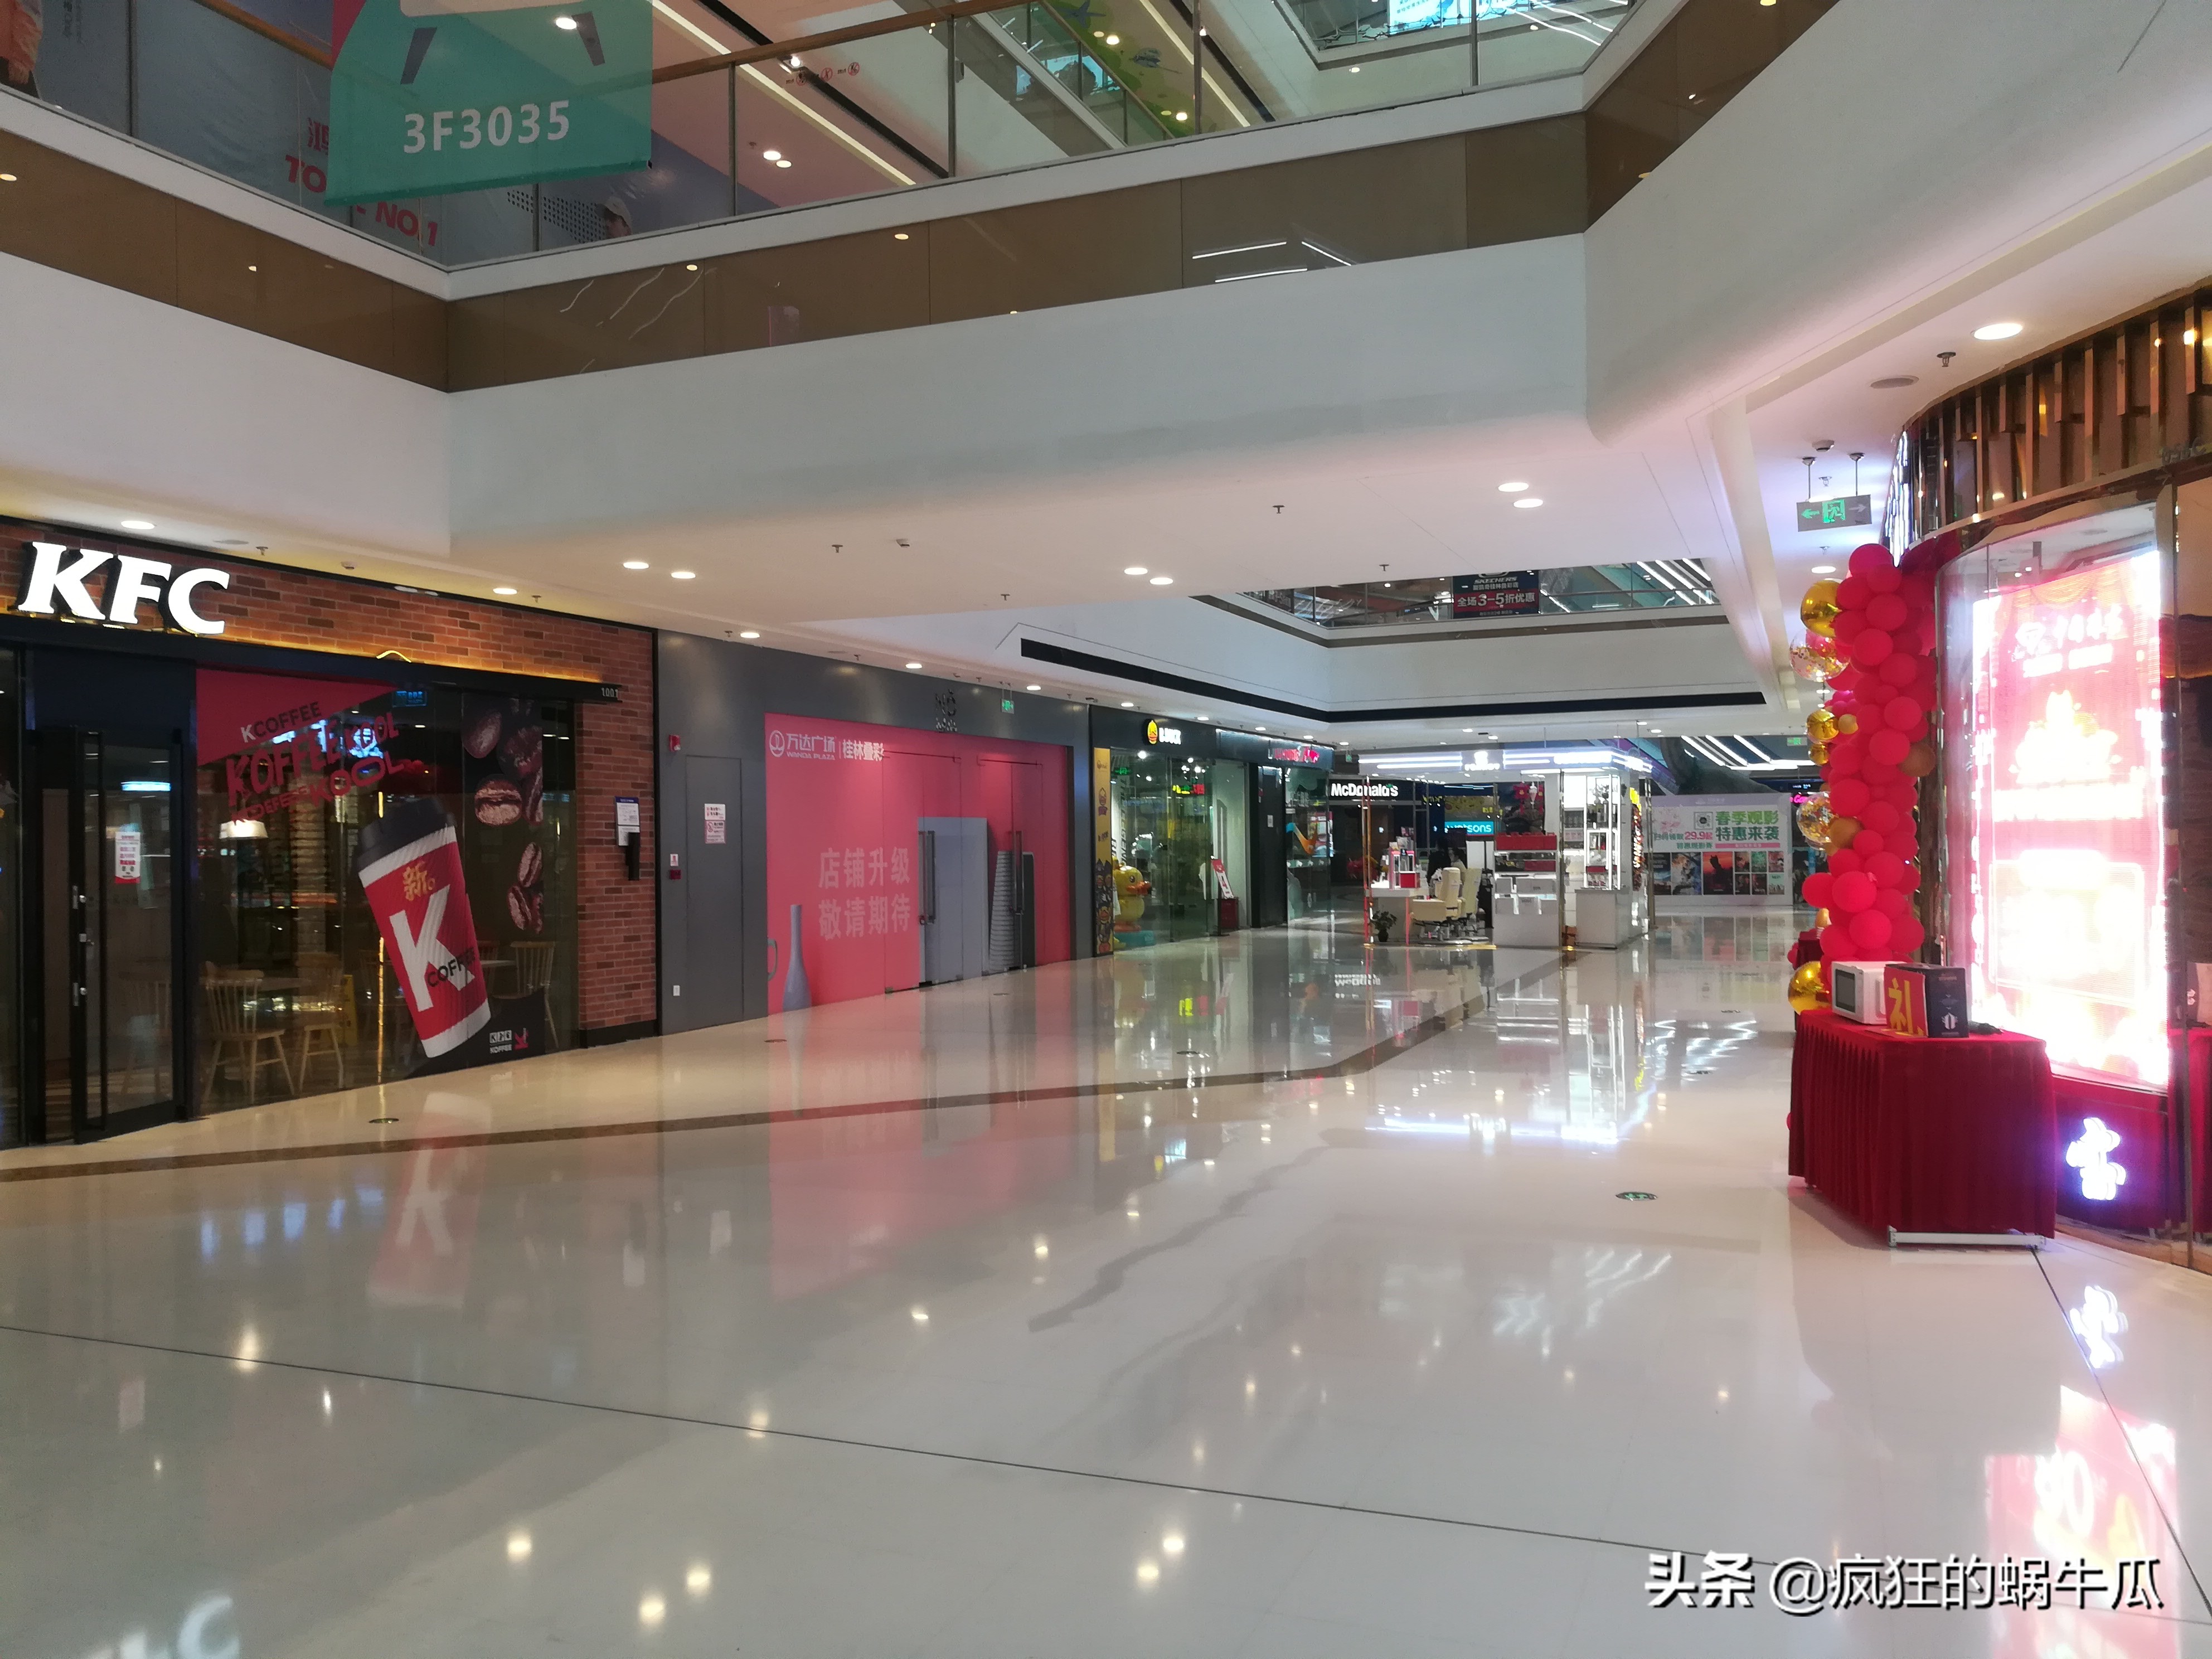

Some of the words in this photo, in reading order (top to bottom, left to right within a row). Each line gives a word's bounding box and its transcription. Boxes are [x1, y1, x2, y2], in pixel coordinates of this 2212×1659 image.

[403, 100, 569, 153] 3F3035
[18, 542, 230, 634] KFC
[1457, 592, 1535, 608] 全场3-5折优惠
[601, 687, 619, 697] 1001
[240, 701, 322, 743] KCOFFEE
[787, 733, 836, 753] 万达广场
[842, 739, 884, 761] 桂林叠彩
[787, 751, 812, 759] WANDA
[1331, 783, 1399, 797] McDonalds
[1716, 811, 1778, 825] 春季观影
[1716, 826, 1779, 841] 特惠来袭
[818, 847, 910, 889] 店铺升级
[818, 893, 910, 940] 敬请期待
[1889, 977, 1913, 1034] 礼
